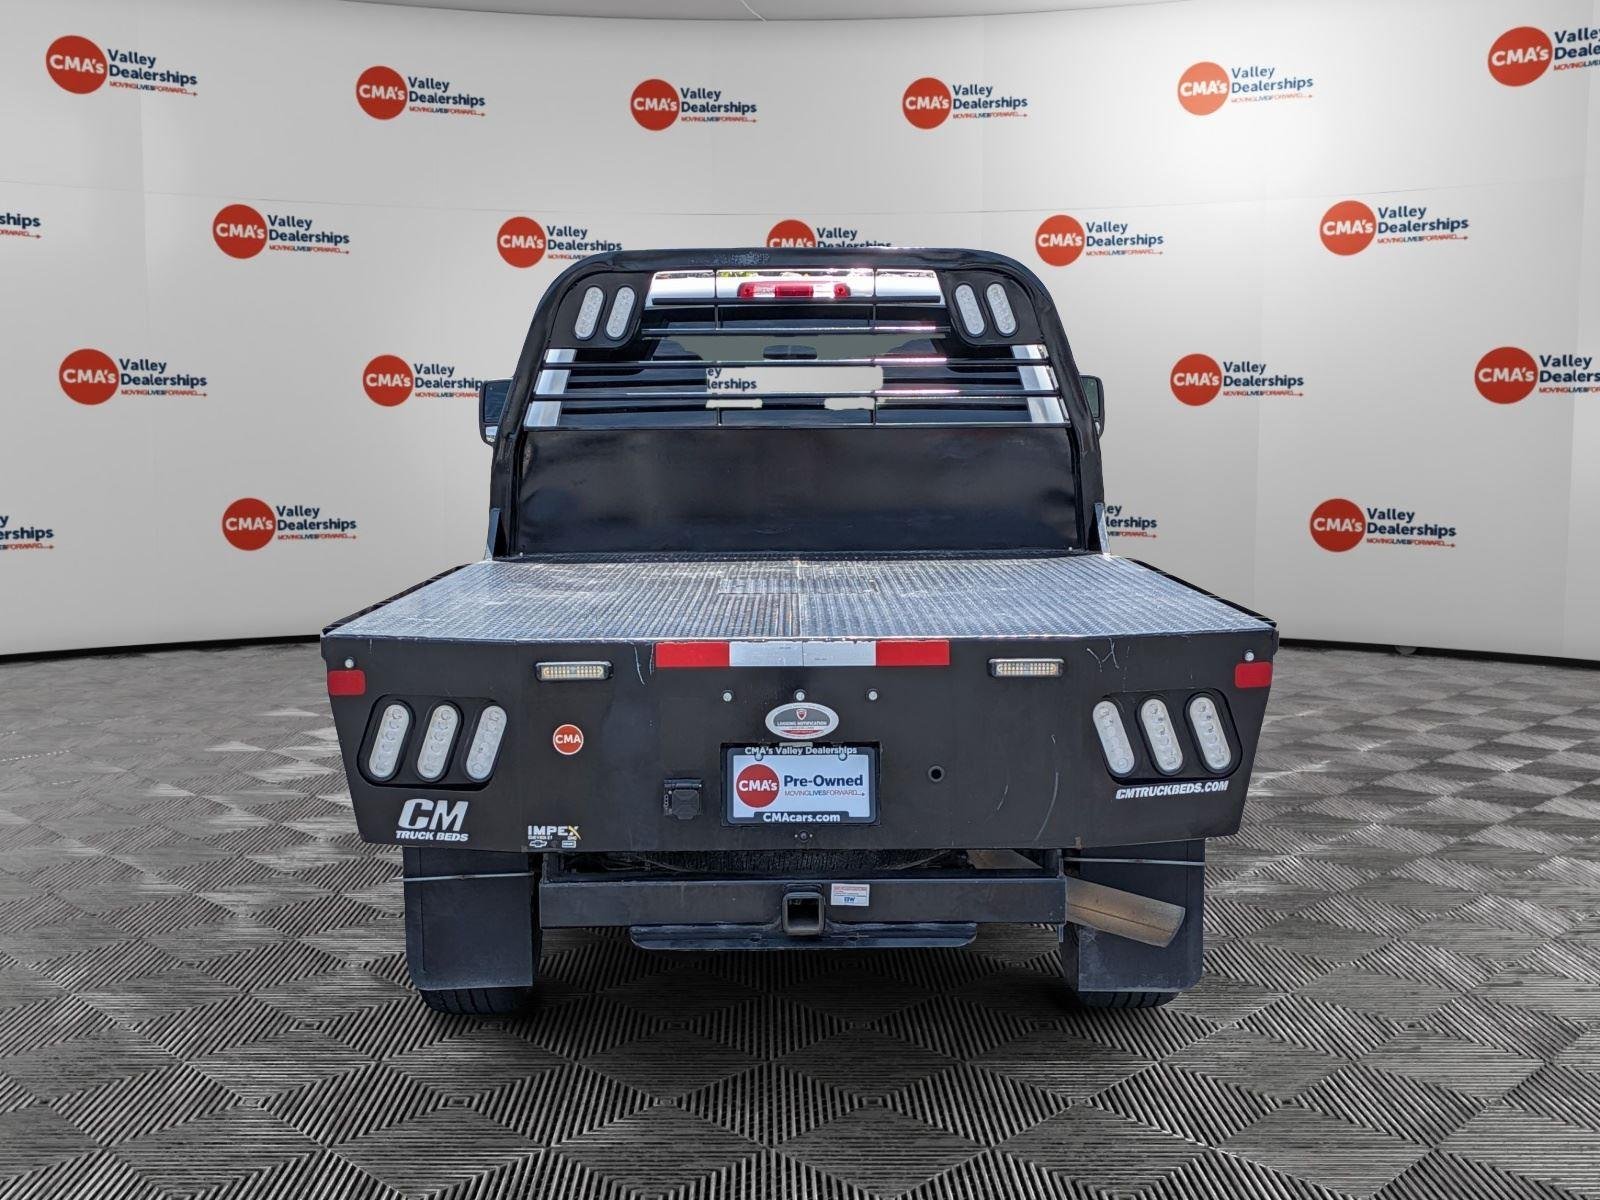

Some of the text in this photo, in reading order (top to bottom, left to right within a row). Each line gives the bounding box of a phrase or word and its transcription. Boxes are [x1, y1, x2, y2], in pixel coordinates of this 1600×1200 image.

[1555, 28, 1600, 43] Valle
[108, 49, 156, 68] Valley
[1492, 46, 1549, 66] CMA's
[50, 55, 104, 74] CMA's
[109, 65, 197, 86] Dealerships
[1232, 66, 1275, 79] Valley
[408, 77, 449, 93] Valley
[952, 85, 993, 97] Valley
[1180, 80, 1227, 96] CMA's
[1232, 77, 1313, 93] Dealerships
[359, 85, 405, 100] CMA's
[409, 91, 485, 108] Dealerships
[681, 88, 721, 101] Valley
[634, 98, 677, 111] CMA's
[682, 102, 756, 115] Dealerships
[906, 96, 949, 110] CMA's
[953, 97, 1027, 110] Dealerships
[1378, 206, 1427, 219] Valley
[268, 215, 312, 230] Valley
[1086, 222, 1128, 234] Valley
[1323, 219, 1373, 235] CMA's
[1378, 218, 1469, 233] Dealerships
[216, 223, 264, 239] CMA's
[269, 229, 349, 245] Dealerships
[547, 226, 587, 239] Valley
[817, 228, 857, 241] Valley
[501, 235, 543, 248] CMA's
[548, 239, 622, 251] Dealerships
[1038, 233, 1082, 247] CMA's
[1087, 234, 1163, 247] Dealerships
[119, 359, 167, 373] Valley
[1223, 362, 1266, 375] Valley
[1540, 354, 1592, 370] Valley
[63, 369, 116, 383] CMA's
[414, 364, 455, 377] Valley
[1479, 367, 1534, 382] CMA's
[121, 373, 207, 388] Dealerships
[366, 374, 411, 387] CMA's
[1173, 373, 1219, 387] CMA's
[1224, 375, 1304, 389] Dealerships
[276, 505, 320, 519] Valley
[1367, 508, 1415, 523] Valley
[226, 517, 273, 531] CMA's
[278, 519, 356, 531] Dealerships
[1313, 517, 1362, 532] CMA's
[1367, 523, 1456, 539] Dealerships
[556, 734, 581, 743] CMA
[745, 746, 857, 756] CMA's Valley Dealerships
[739, 779, 777, 792] CMA's
[784, 775, 863, 787] Pre-Owned
[1115, 780, 1229, 800] CMTRUCKBEDS.COM
[398, 798, 468, 832] CM
[763, 813, 840, 822] CMAcars.com
[396, 830, 469, 842] TRUCK BEDS
[528, 825, 581, 838] IMPEX
